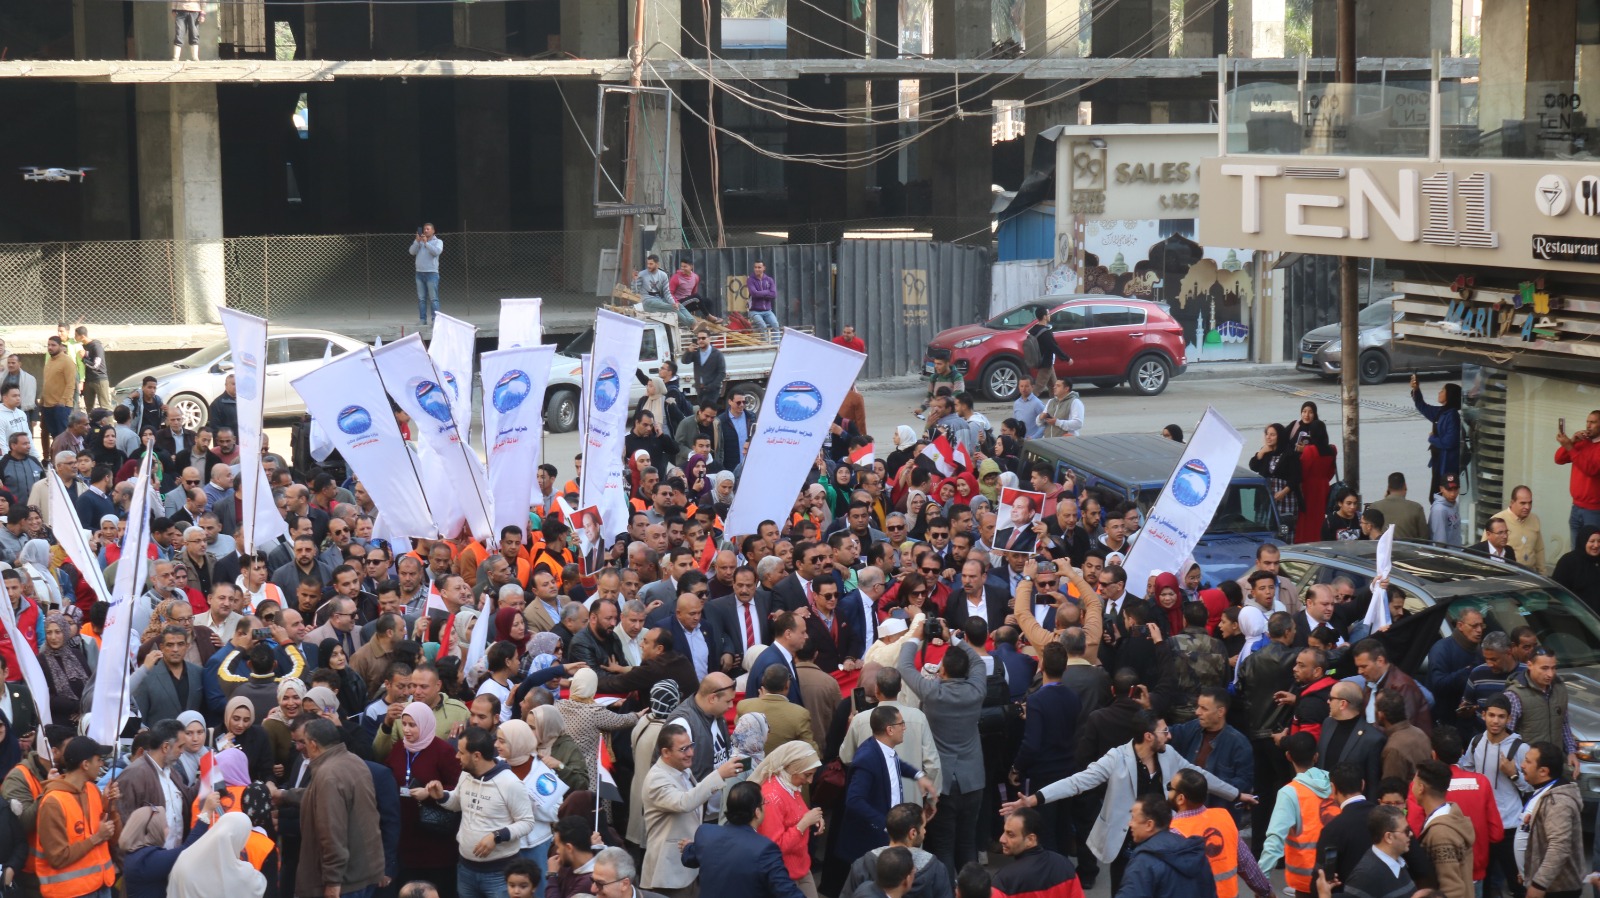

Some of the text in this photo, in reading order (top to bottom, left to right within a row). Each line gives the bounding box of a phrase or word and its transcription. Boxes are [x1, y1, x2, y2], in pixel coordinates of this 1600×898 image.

[1115, 161, 1191, 184] SALES
[1532, 236, 1599, 259] Restaurant
[903, 310, 928, 318] LAND
